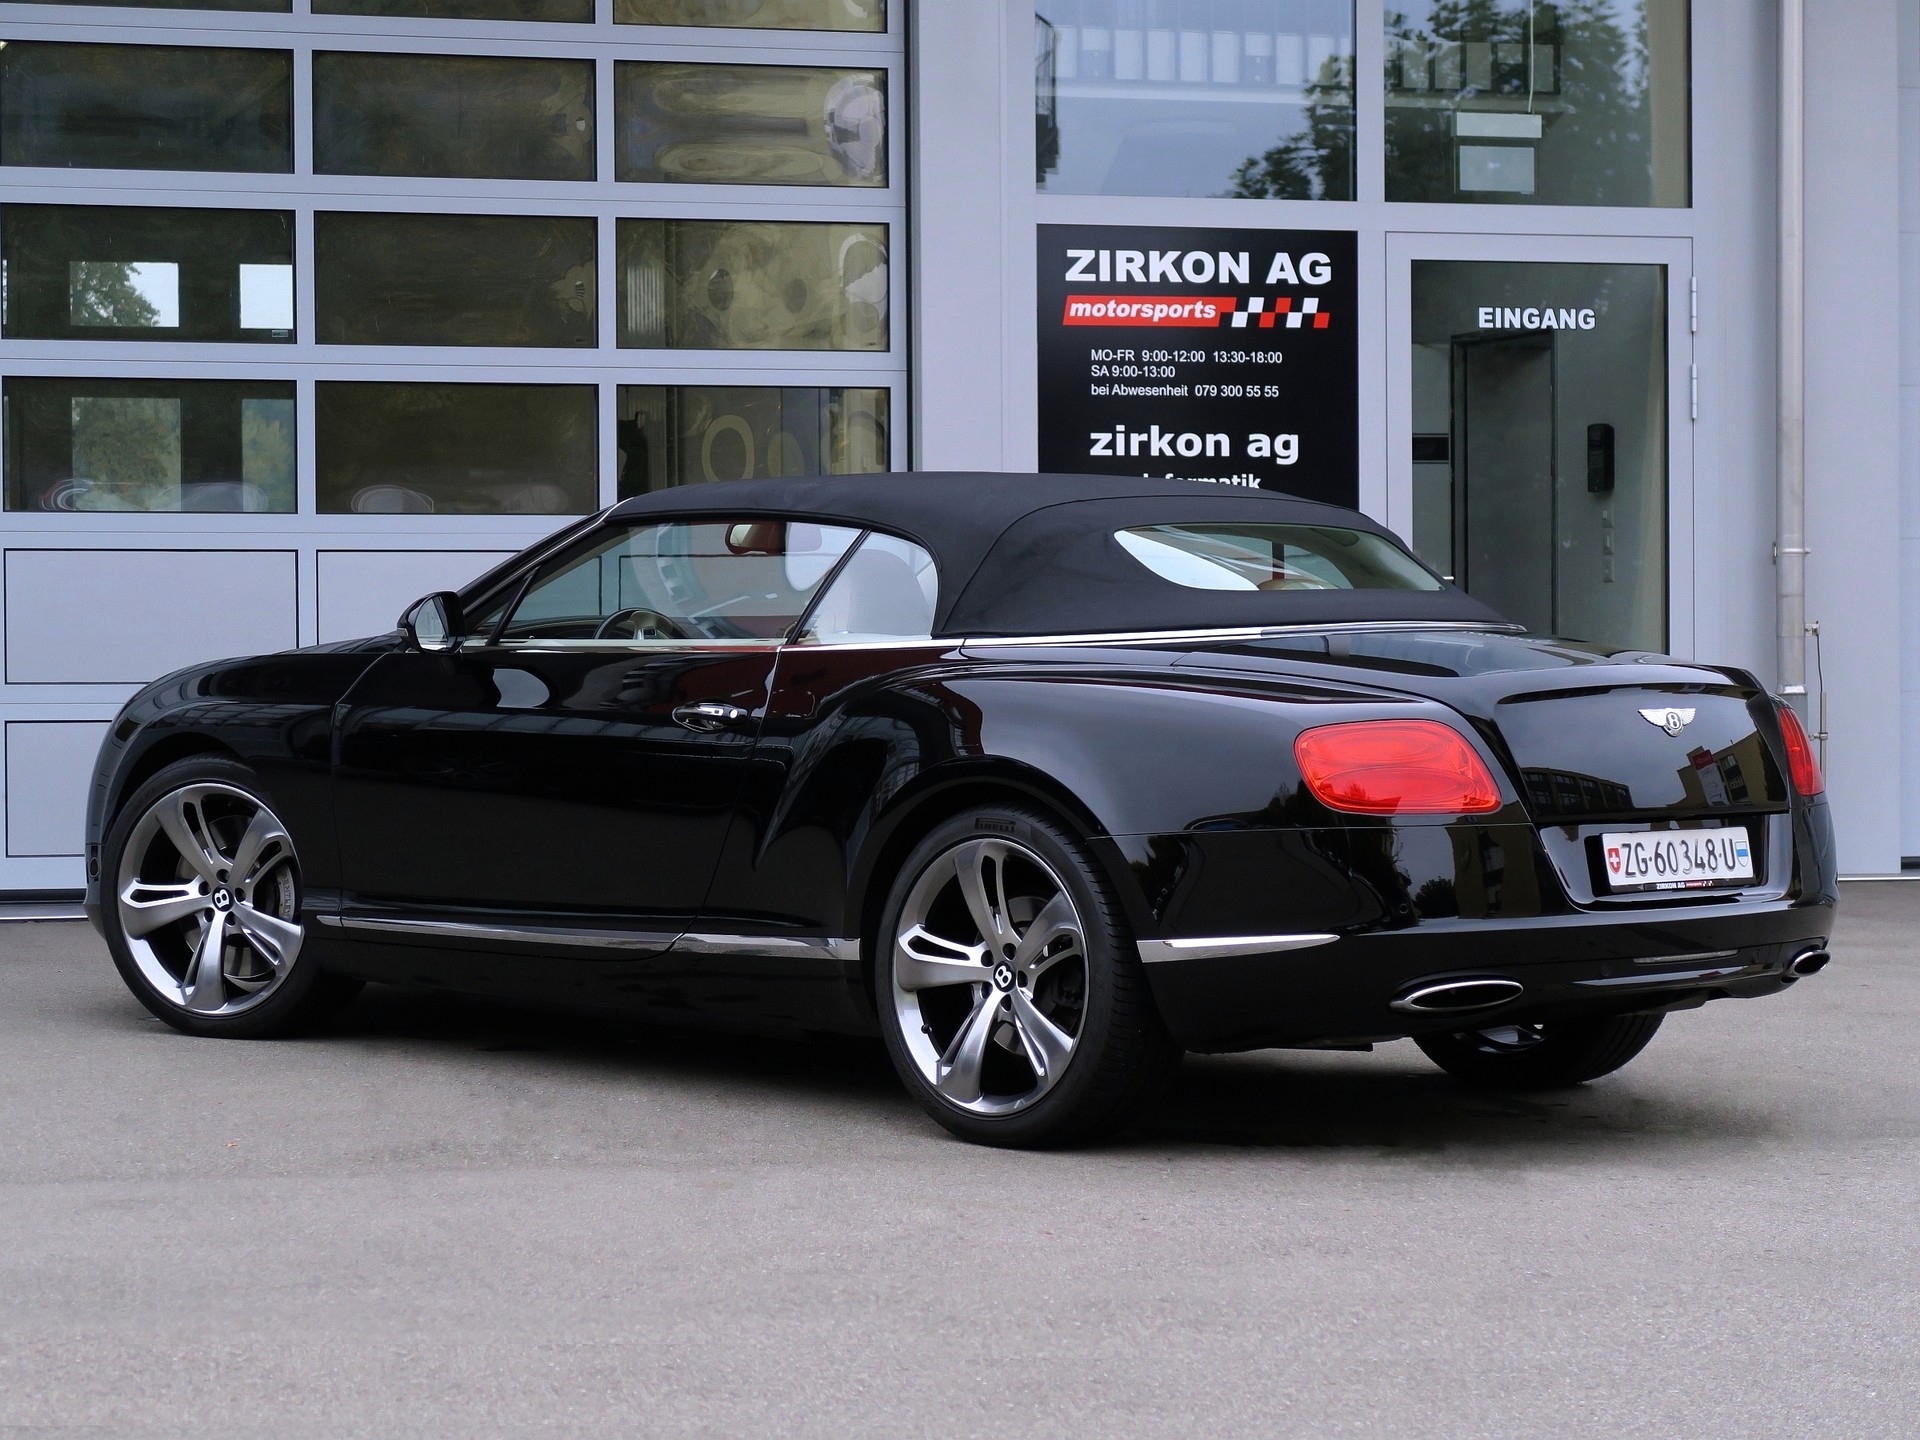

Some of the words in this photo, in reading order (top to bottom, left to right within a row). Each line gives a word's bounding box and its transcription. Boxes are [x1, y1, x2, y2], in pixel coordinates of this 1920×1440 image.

[1065, 249, 1250, 284] ZIRKON
[1265, 252, 1332, 285] AG
[1069, 299, 1216, 322] motorsports
[1478, 306, 1596, 330] EINGANG
[1090, 349, 1135, 362] MO-FR
[1141, 350, 1206, 363] 9:00-12:00
[1213, 350, 1283, 364] 13:30-18:00
[1090, 364, 1110, 377] SA
[1111, 365, 1176, 378] 9:00-13:00
[1090, 383, 1110, 396] bei
[1111, 384, 1189, 397] Abwesenheit
[1194, 384, 1218, 397] 079
[1220, 385, 1243, 398] 300
[1246, 385, 1261, 398] 55
[1264, 385, 1280, 398] 55
[1089, 425, 1230, 457] zirkon
[1247, 432, 1299, 465] ag
